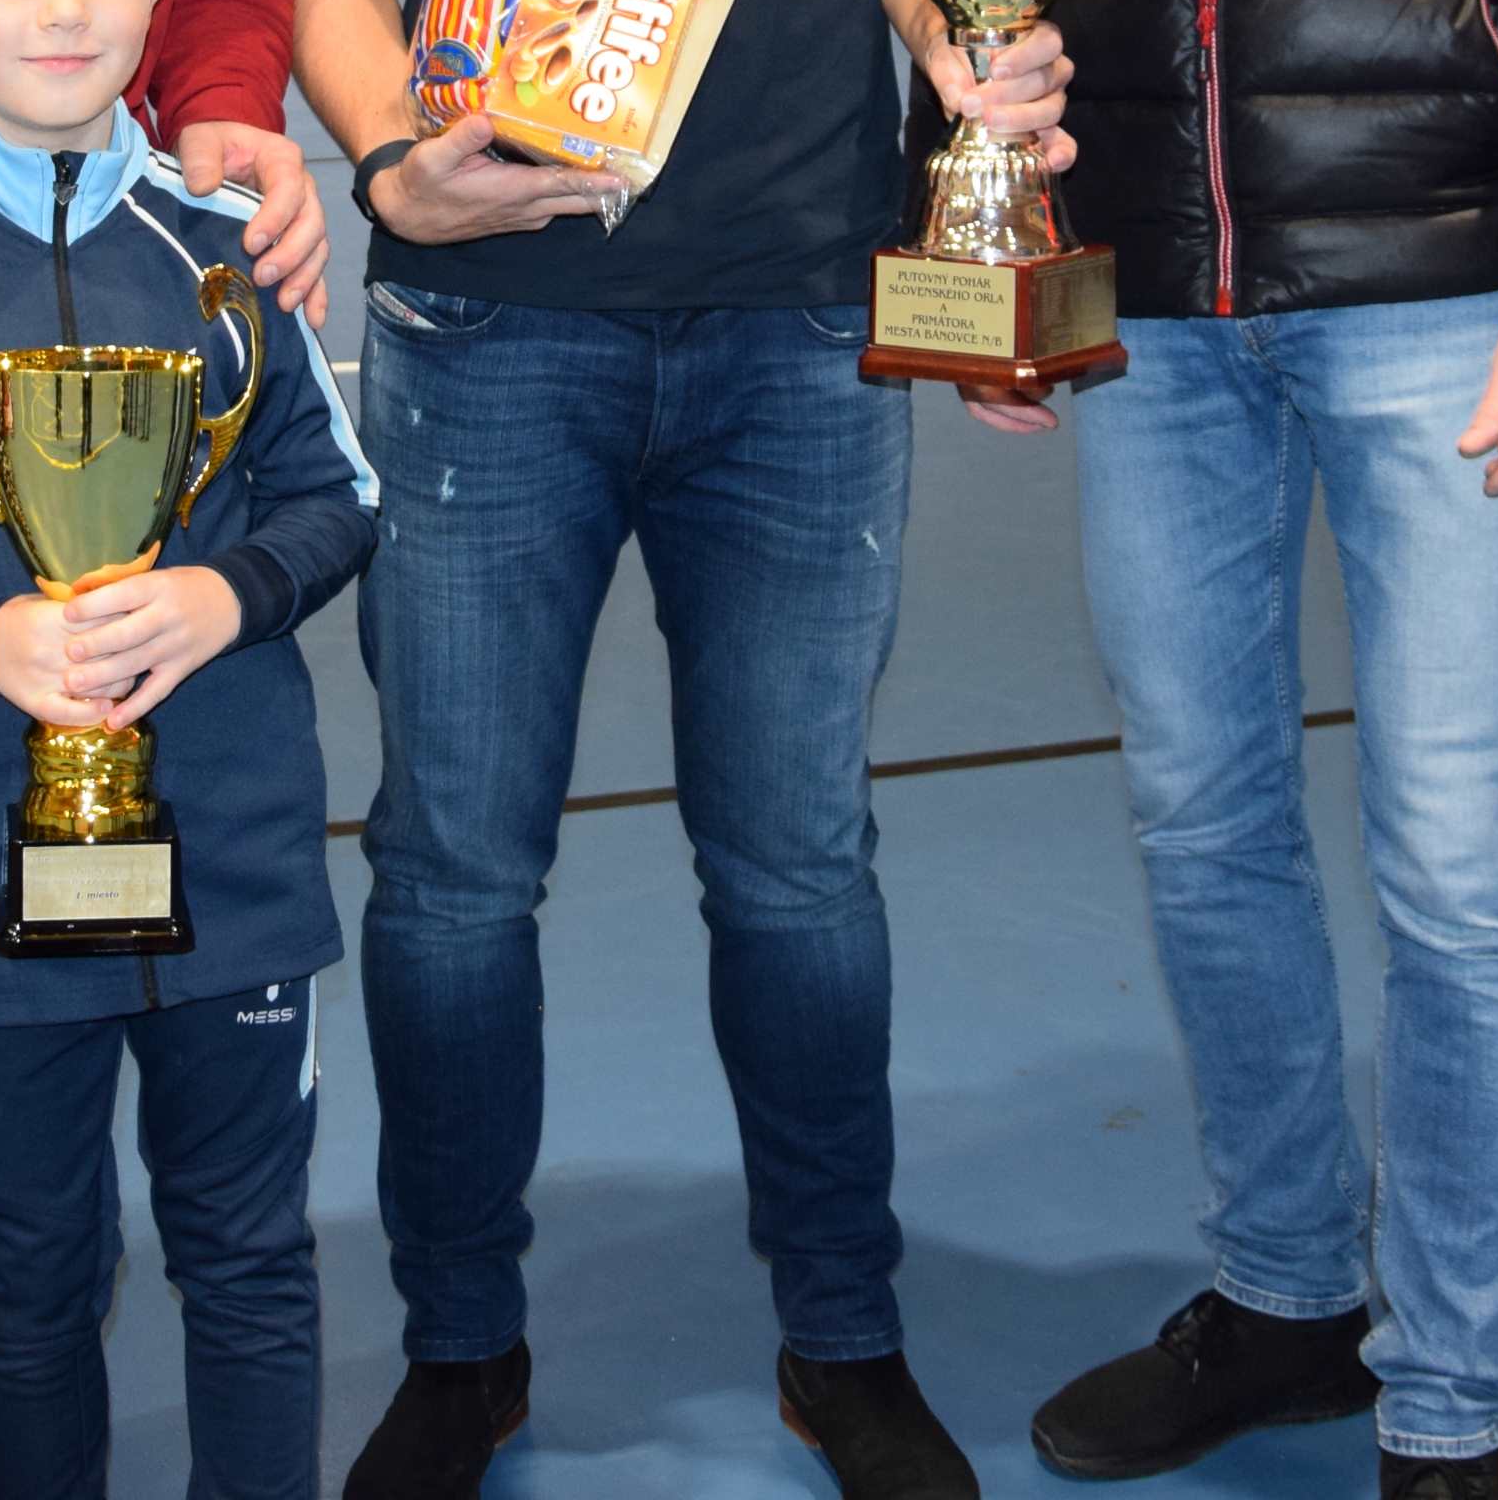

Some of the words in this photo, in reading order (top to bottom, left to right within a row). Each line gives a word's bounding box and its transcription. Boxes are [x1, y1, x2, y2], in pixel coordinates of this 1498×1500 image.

[973, 291, 1005, 305] ORLA
[939, 302, 948, 313] A
[911, 313, 975, 330] PRIMÁTORA
[884, 324, 921, 339] MESTA
[924, 328, 979, 345] BÁNOVCE
[981, 334, 1003, 347] N/B
